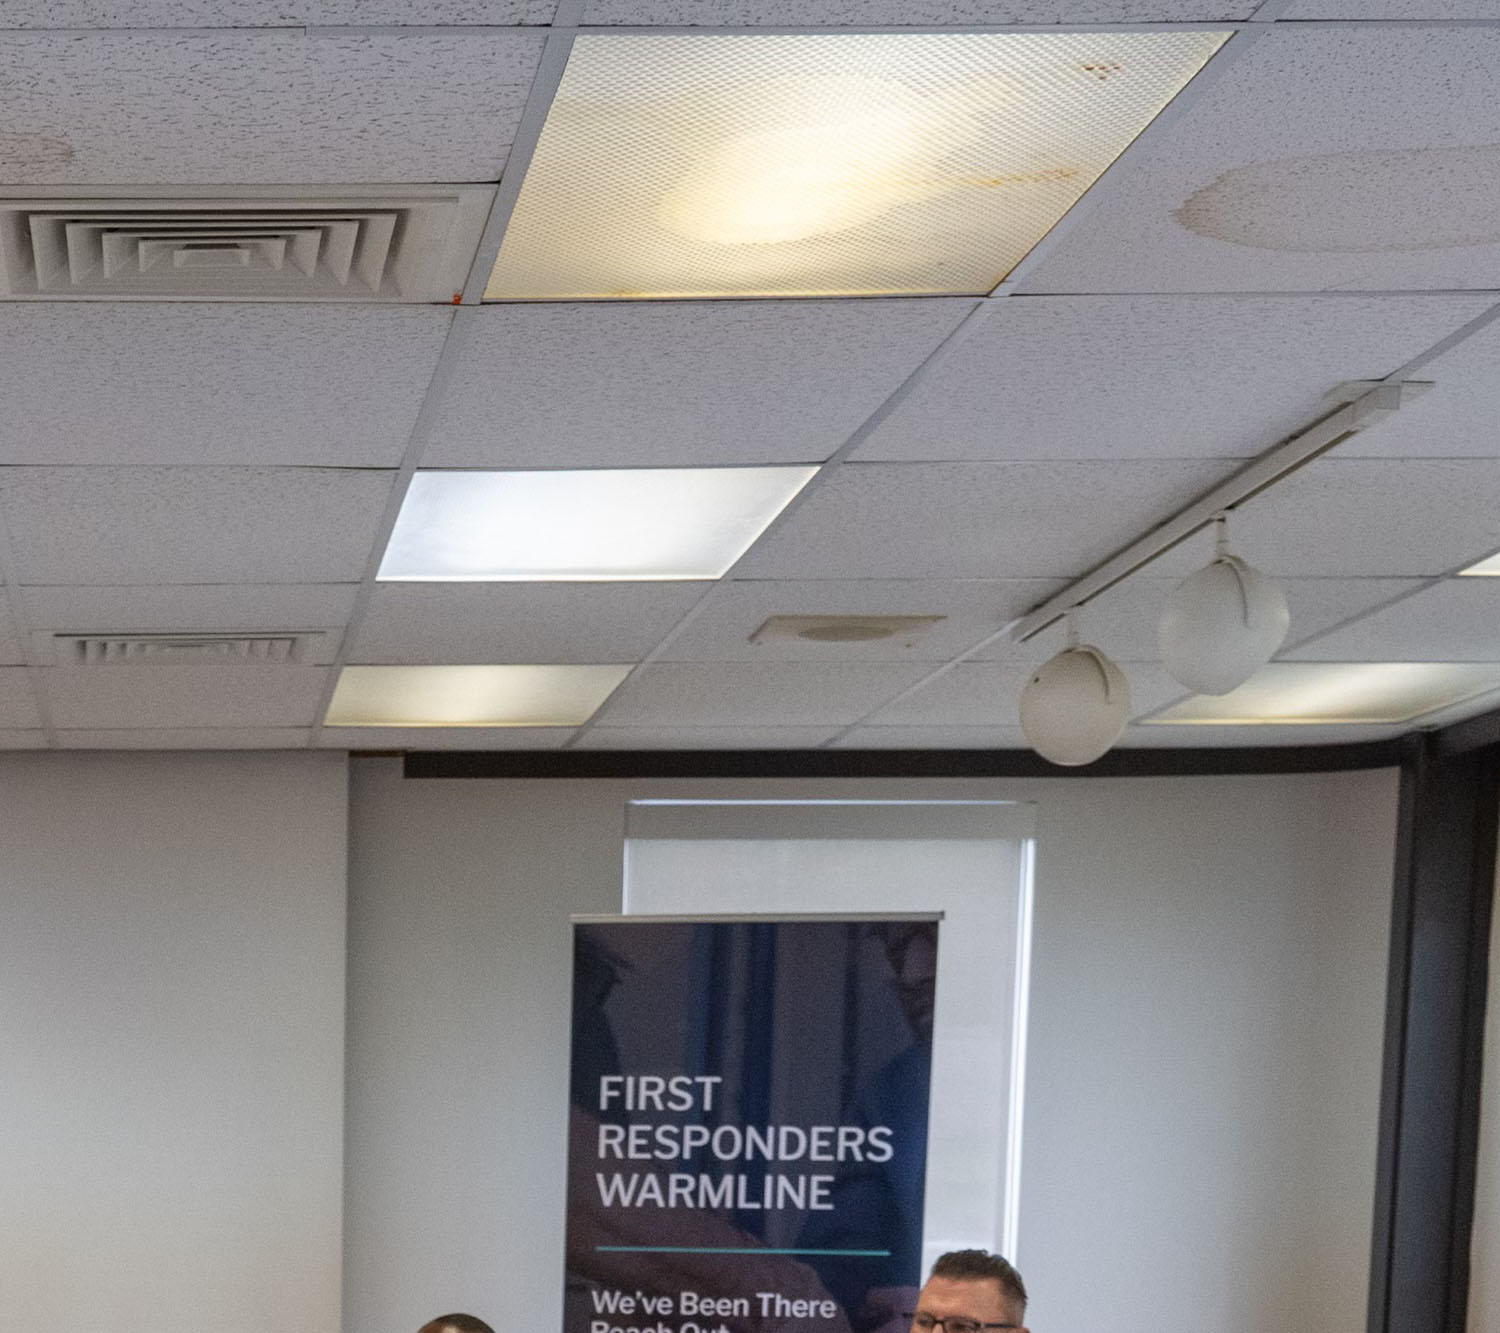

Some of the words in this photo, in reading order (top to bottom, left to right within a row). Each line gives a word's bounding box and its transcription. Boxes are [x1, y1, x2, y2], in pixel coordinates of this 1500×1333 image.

[599, 1075, 722, 1111] FIRST
[598, 1124, 895, 1163] RESPONDERS
[596, 1173, 836, 1211] WARMLINE
[591, 1290, 674, 1315] We've
[680, 1291, 750, 1317] Been
[756, 1292, 838, 1319] There
